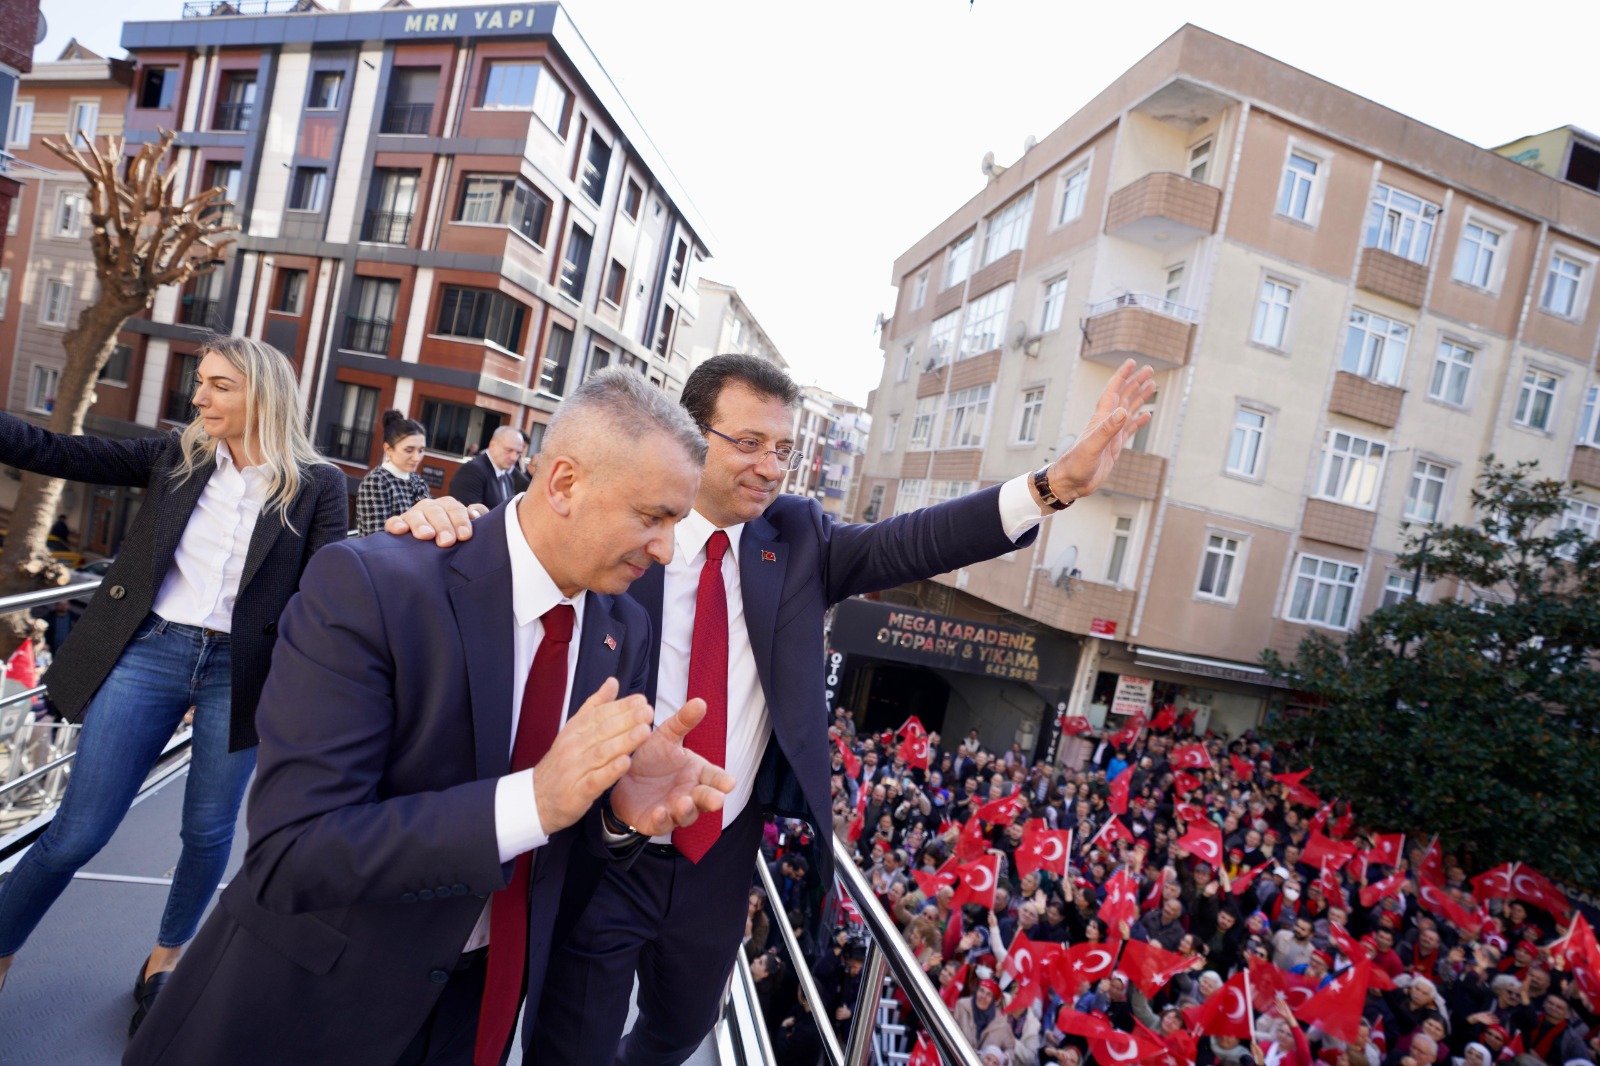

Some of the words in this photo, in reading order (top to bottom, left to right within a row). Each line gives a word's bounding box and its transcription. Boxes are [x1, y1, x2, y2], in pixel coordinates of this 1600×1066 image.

[404, 13, 458, 32] MRN
[474, 8, 535, 30] YAPI
[877, 627, 959, 657] OTOPARK
[961, 644, 974, 659] &
[978, 645, 1039, 670] YIKAMA
[888, 612, 936, 635] MEGA
[940, 621, 1036, 651] KARADENİZ
[827, 652, 843, 686] OTO
